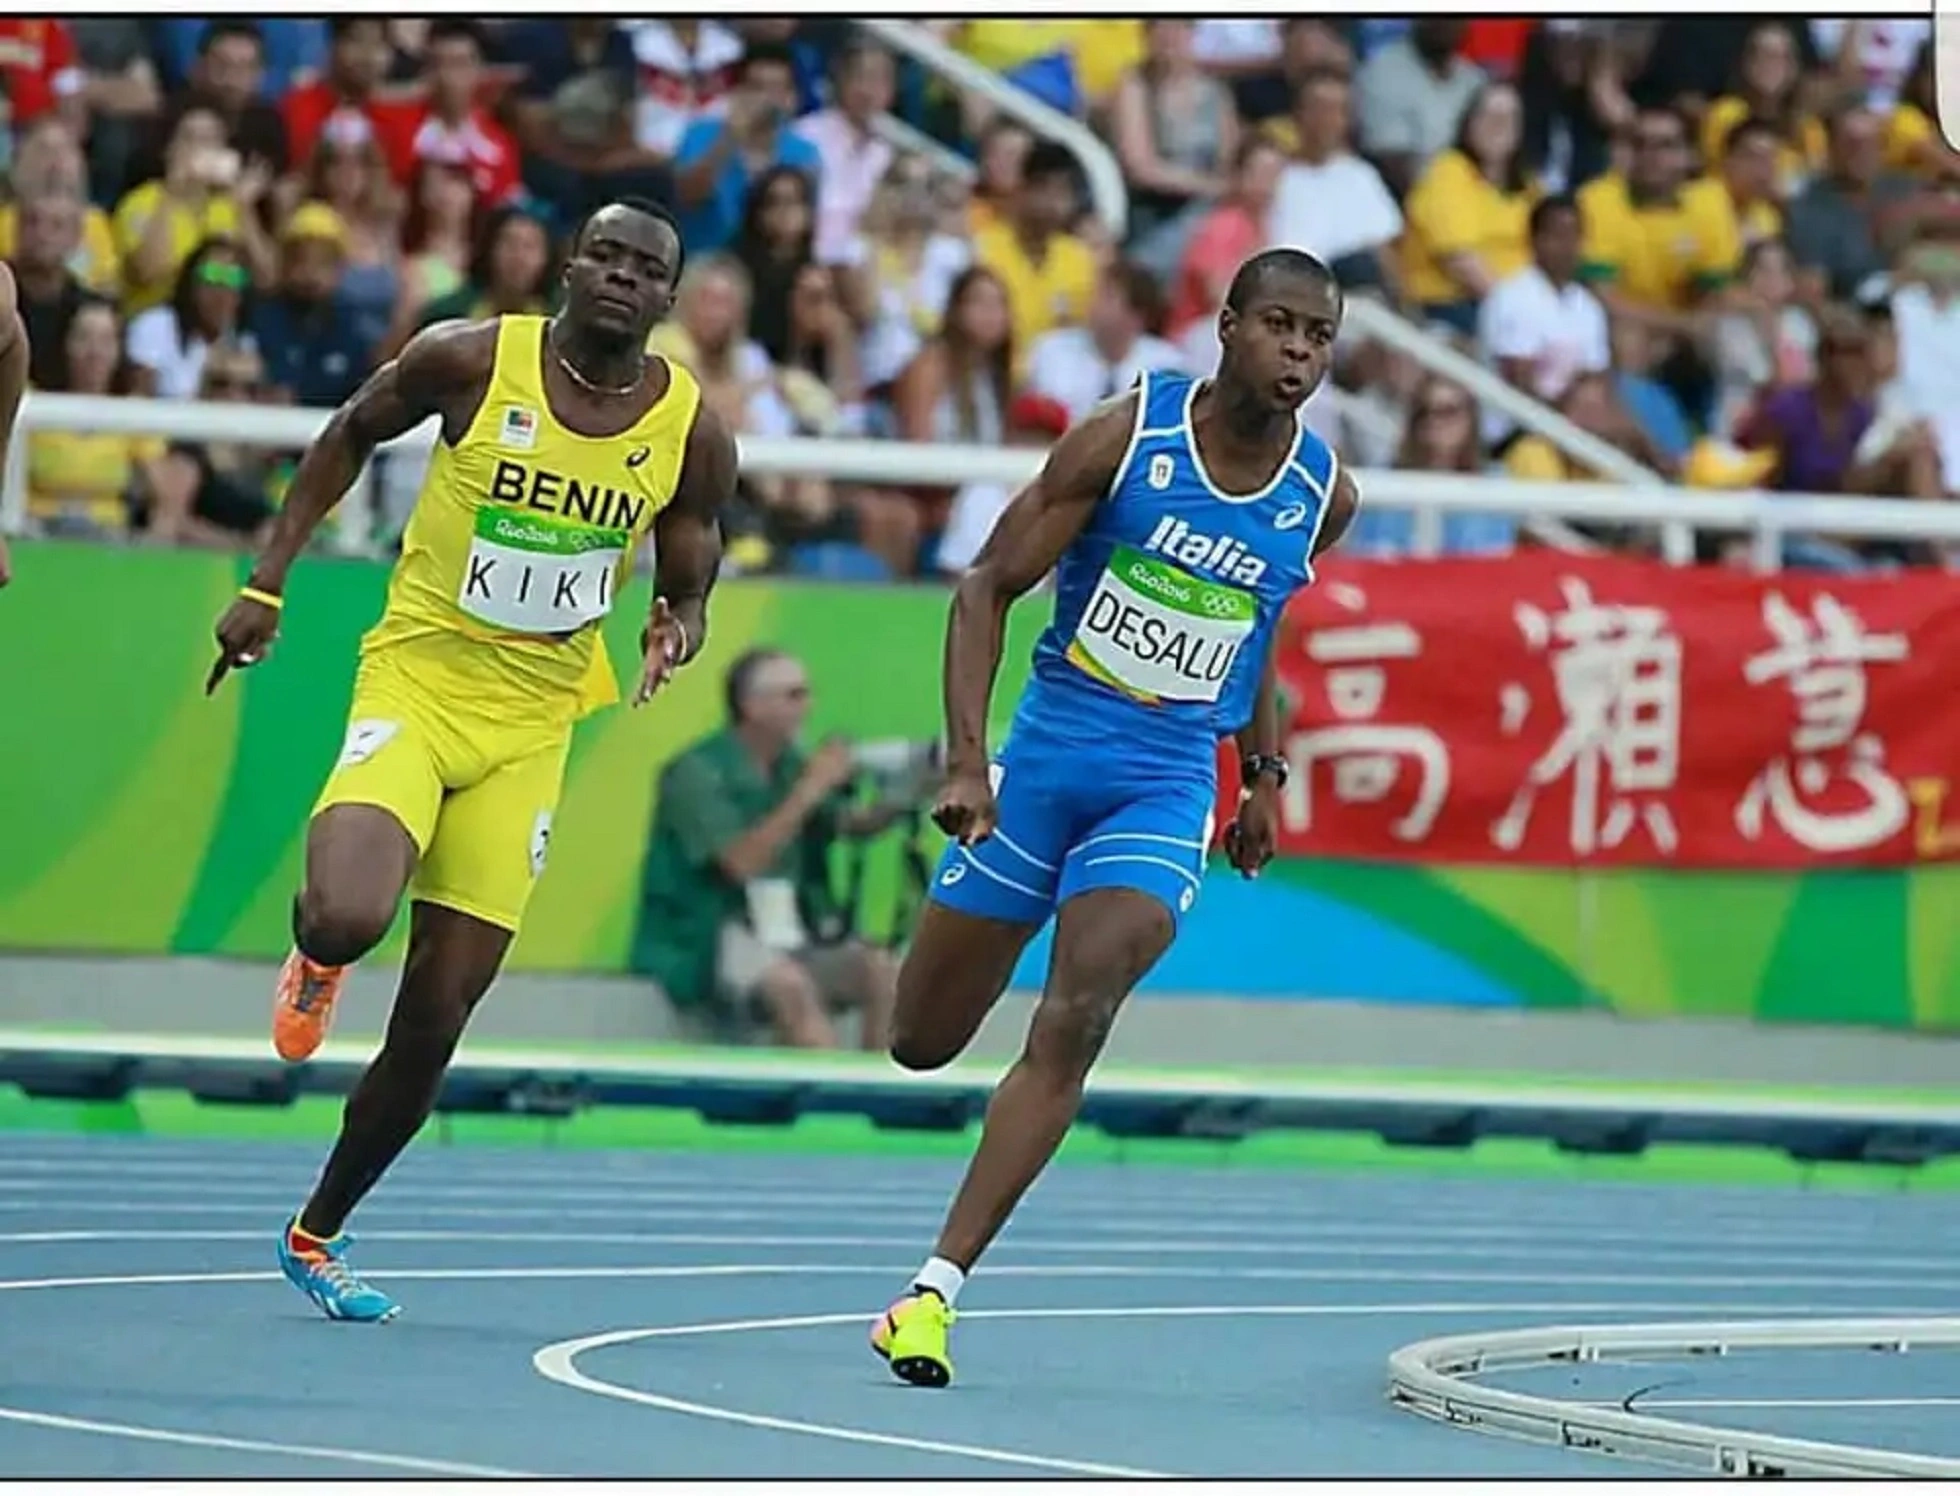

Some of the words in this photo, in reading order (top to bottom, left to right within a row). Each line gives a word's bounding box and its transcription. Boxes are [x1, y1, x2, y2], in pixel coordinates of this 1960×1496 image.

[492, 461, 645, 529] BENIN
[466, 555, 609, 608] KIKI
[1143, 514, 1267, 586] Italia
[1087, 590, 1235, 681] DESALU
